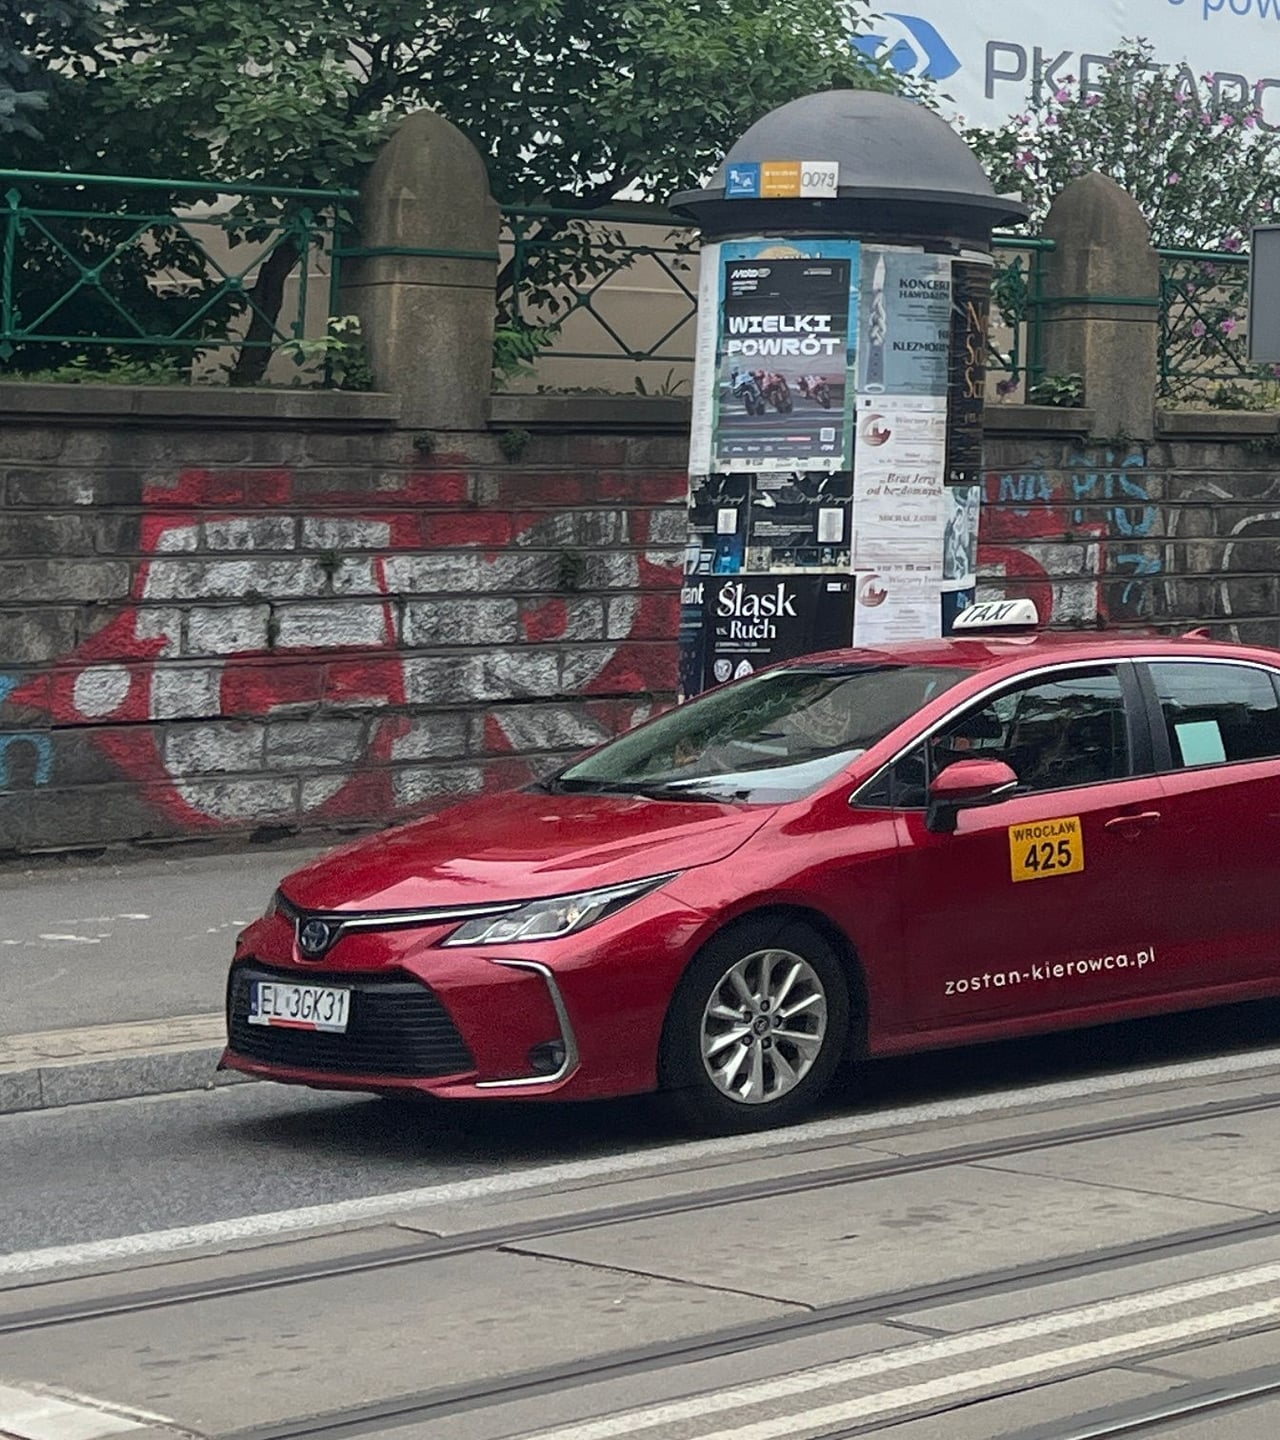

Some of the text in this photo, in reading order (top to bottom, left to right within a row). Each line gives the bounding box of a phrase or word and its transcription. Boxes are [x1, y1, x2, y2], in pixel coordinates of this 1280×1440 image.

[728, 314, 832, 334] WIELKI
[727, 334, 841, 357] POWRÓT
[716, 581, 798, 623] Śląsk
[963, 603, 1017, 623] TAXI
[730, 618, 777, 640] Ruch
[1013, 821, 1077, 842] WROCŁAW
[1024, 839, 1073, 872] 425
[944, 946, 1156, 996] zostan-kierowca.pl
[260, 985, 345, 1023] EL 3GK31
